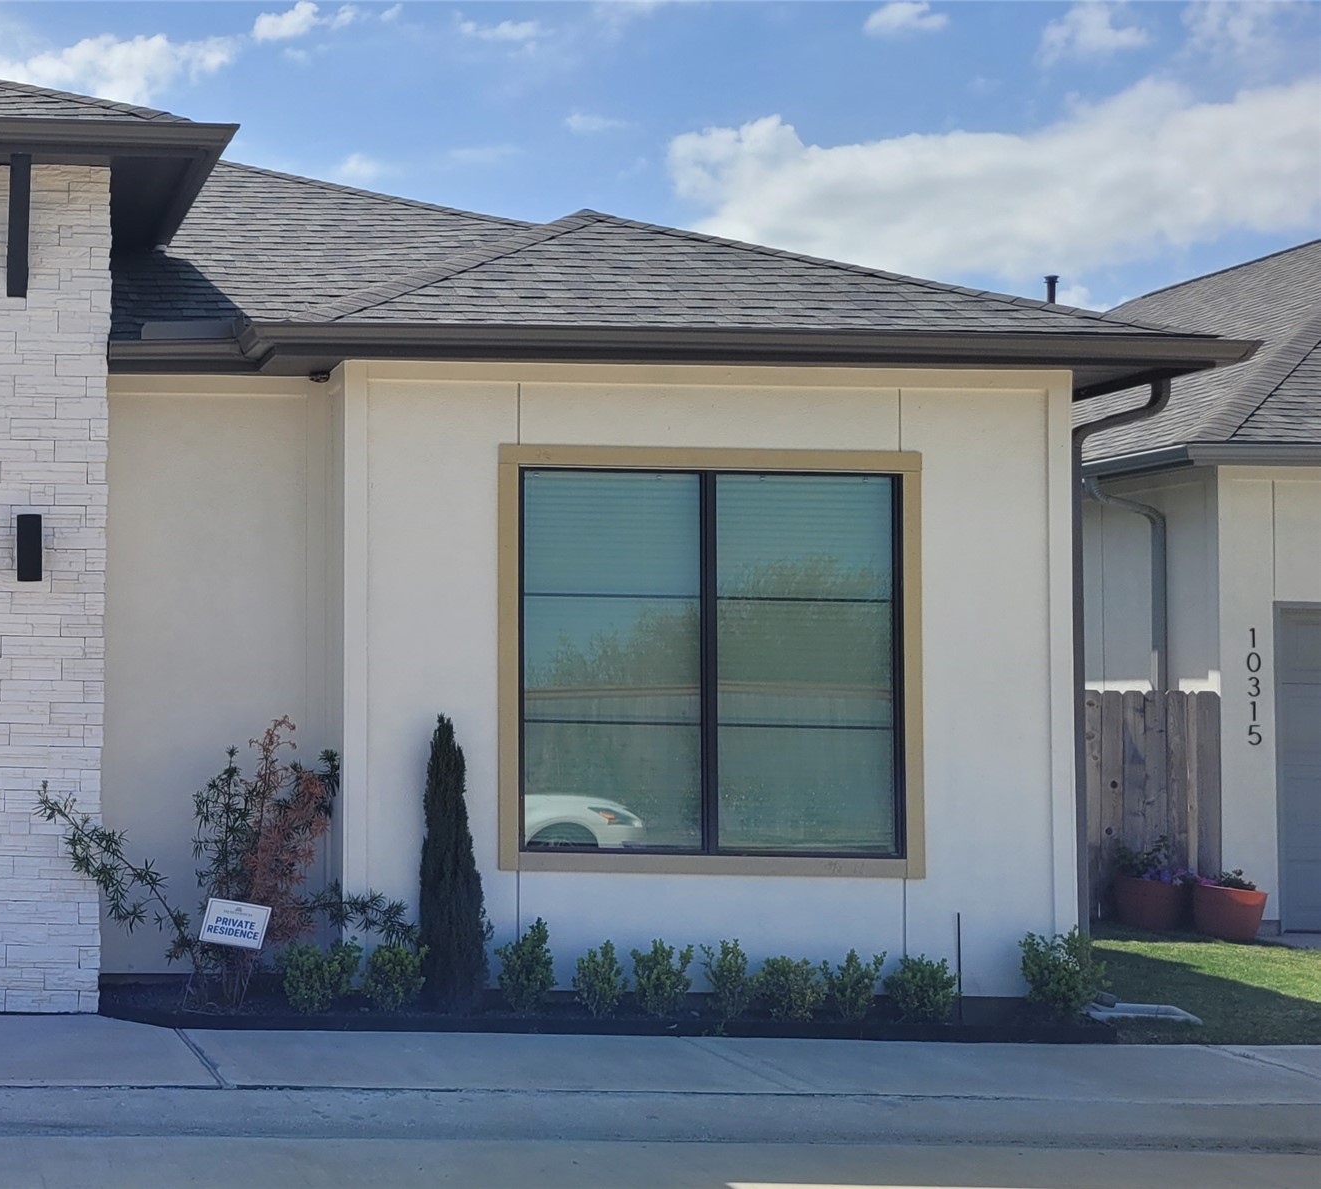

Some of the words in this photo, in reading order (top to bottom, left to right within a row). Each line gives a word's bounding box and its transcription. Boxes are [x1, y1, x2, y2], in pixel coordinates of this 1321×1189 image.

[1246, 627, 1263, 746] 10315
[215, 916, 256, 930] PRIVATE
[206, 925, 259, 940] RESIDENCE
